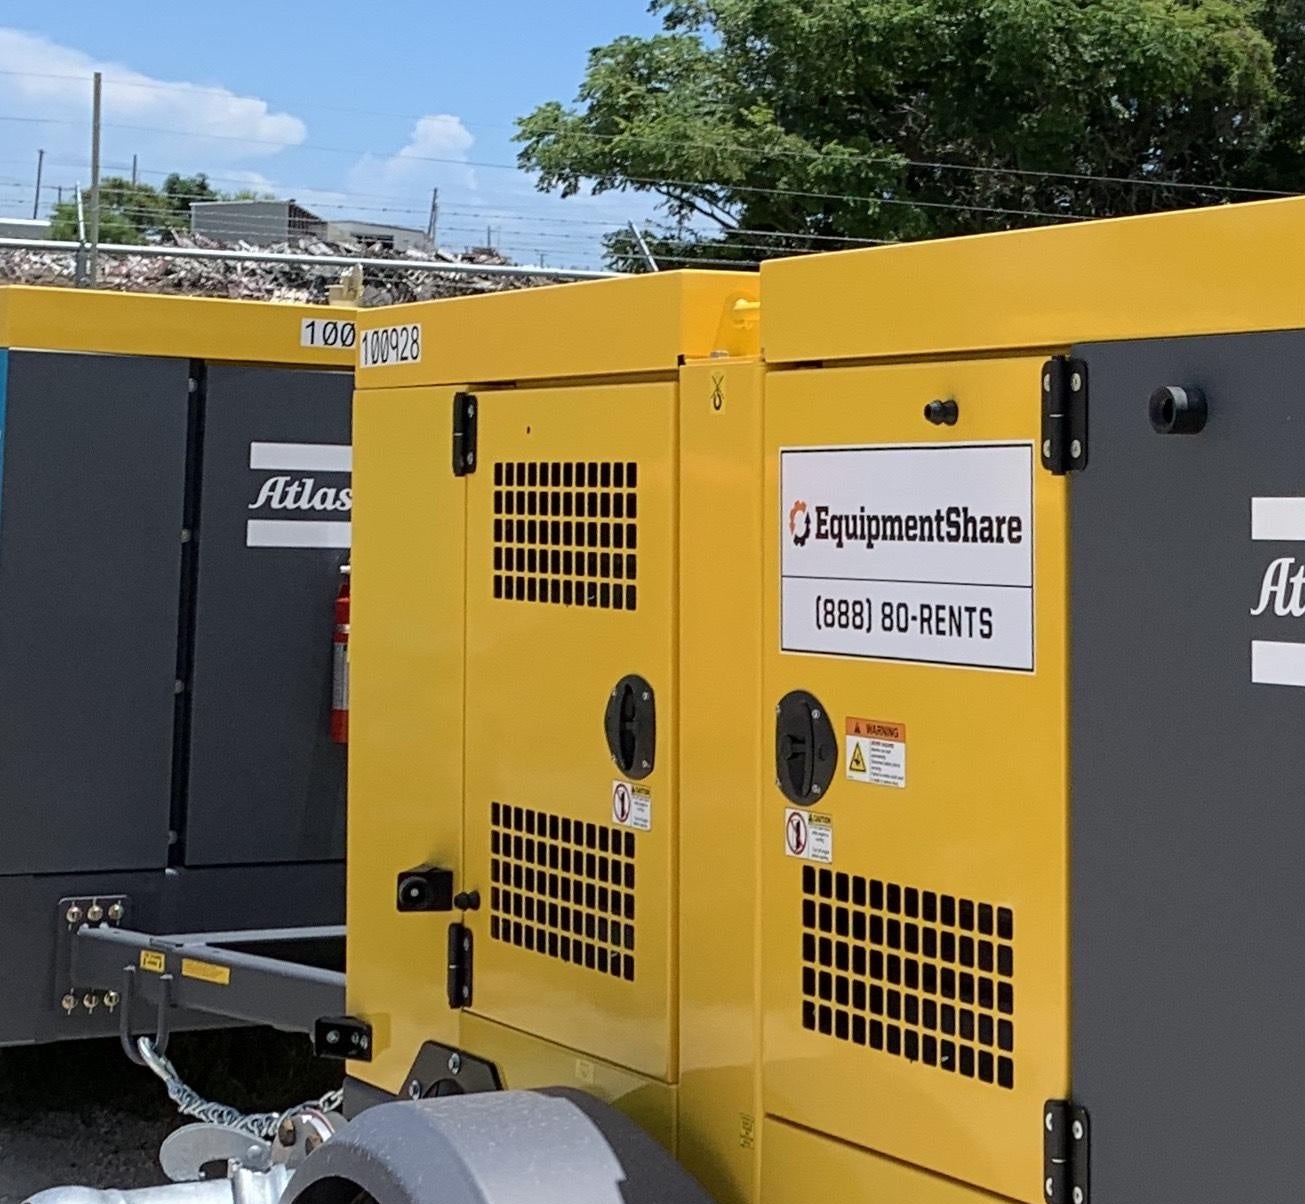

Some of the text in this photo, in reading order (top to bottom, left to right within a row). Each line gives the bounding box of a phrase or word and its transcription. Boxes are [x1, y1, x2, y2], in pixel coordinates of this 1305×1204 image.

[362, 326, 420, 365] 100928
[248, 476, 352, 511] Atlas
[815, 506, 1023, 549] EquipmentShare
[815, 594, 993, 639] (888) 80-RENTS
[866, 723, 899, 738] WARNING
